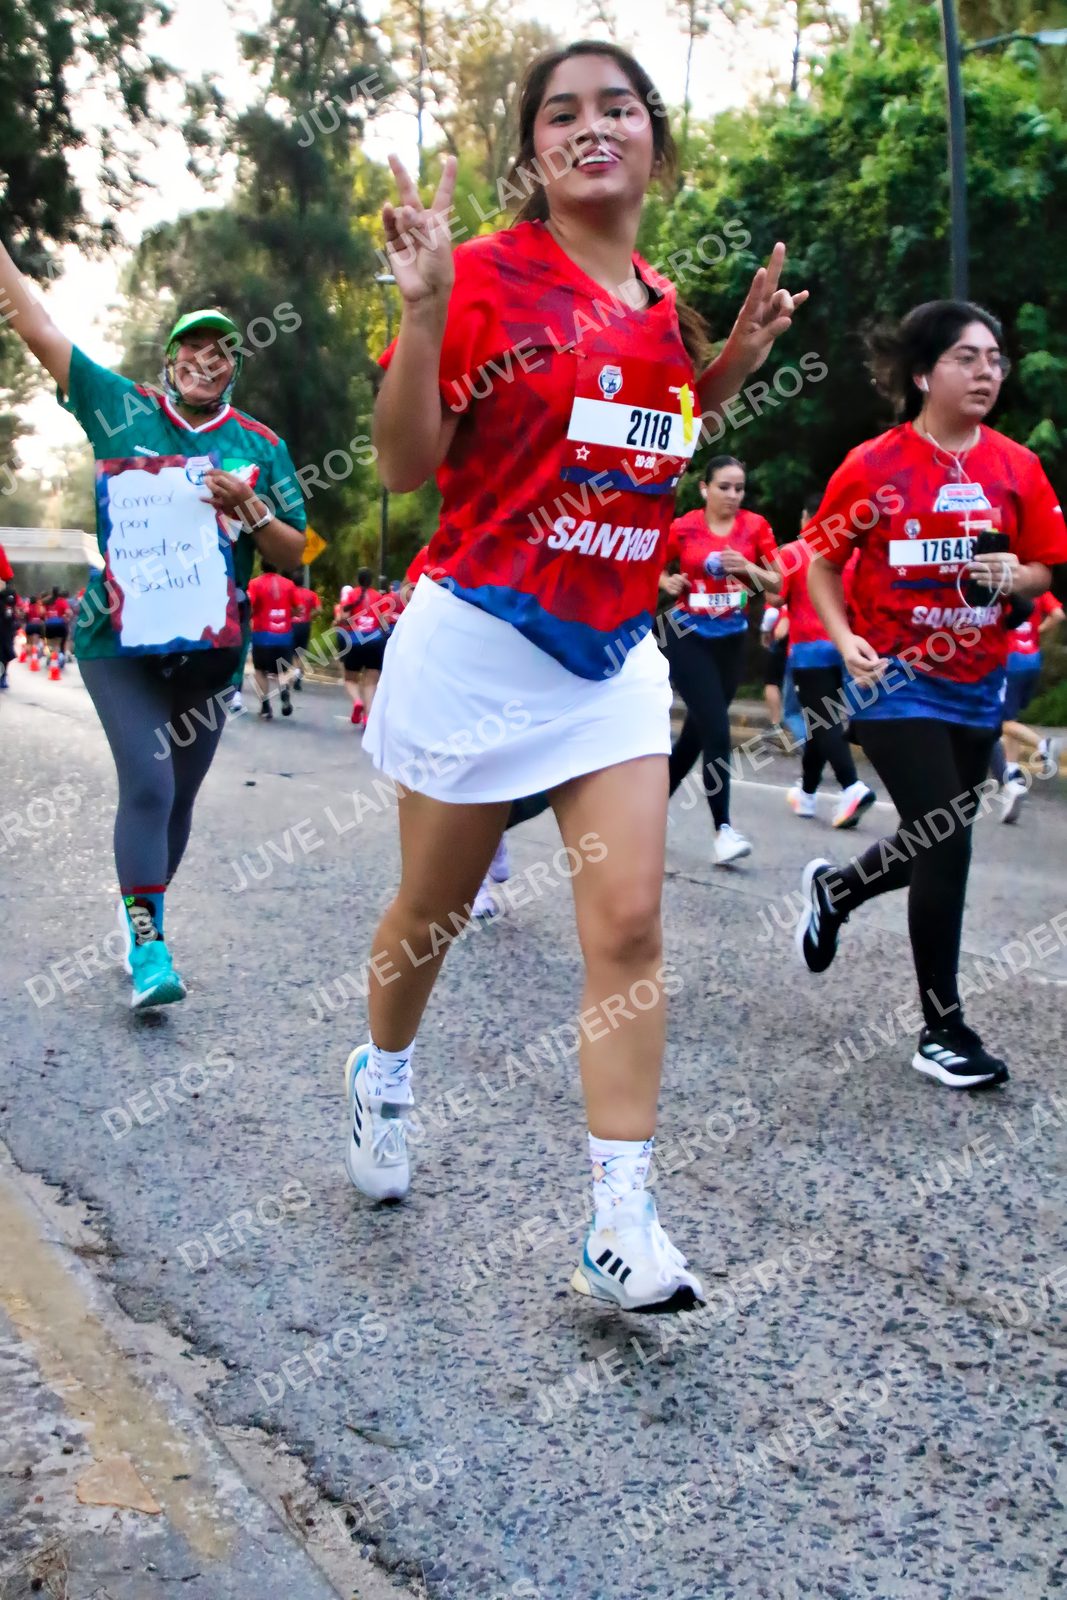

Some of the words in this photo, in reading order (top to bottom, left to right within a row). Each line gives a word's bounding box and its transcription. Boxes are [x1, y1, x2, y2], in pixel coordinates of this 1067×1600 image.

[626, 409, 672, 450] 2118
[112, 489, 175, 510] Correr
[119, 517, 149, 538] por
[547, 515, 660, 563] SANTAGO
